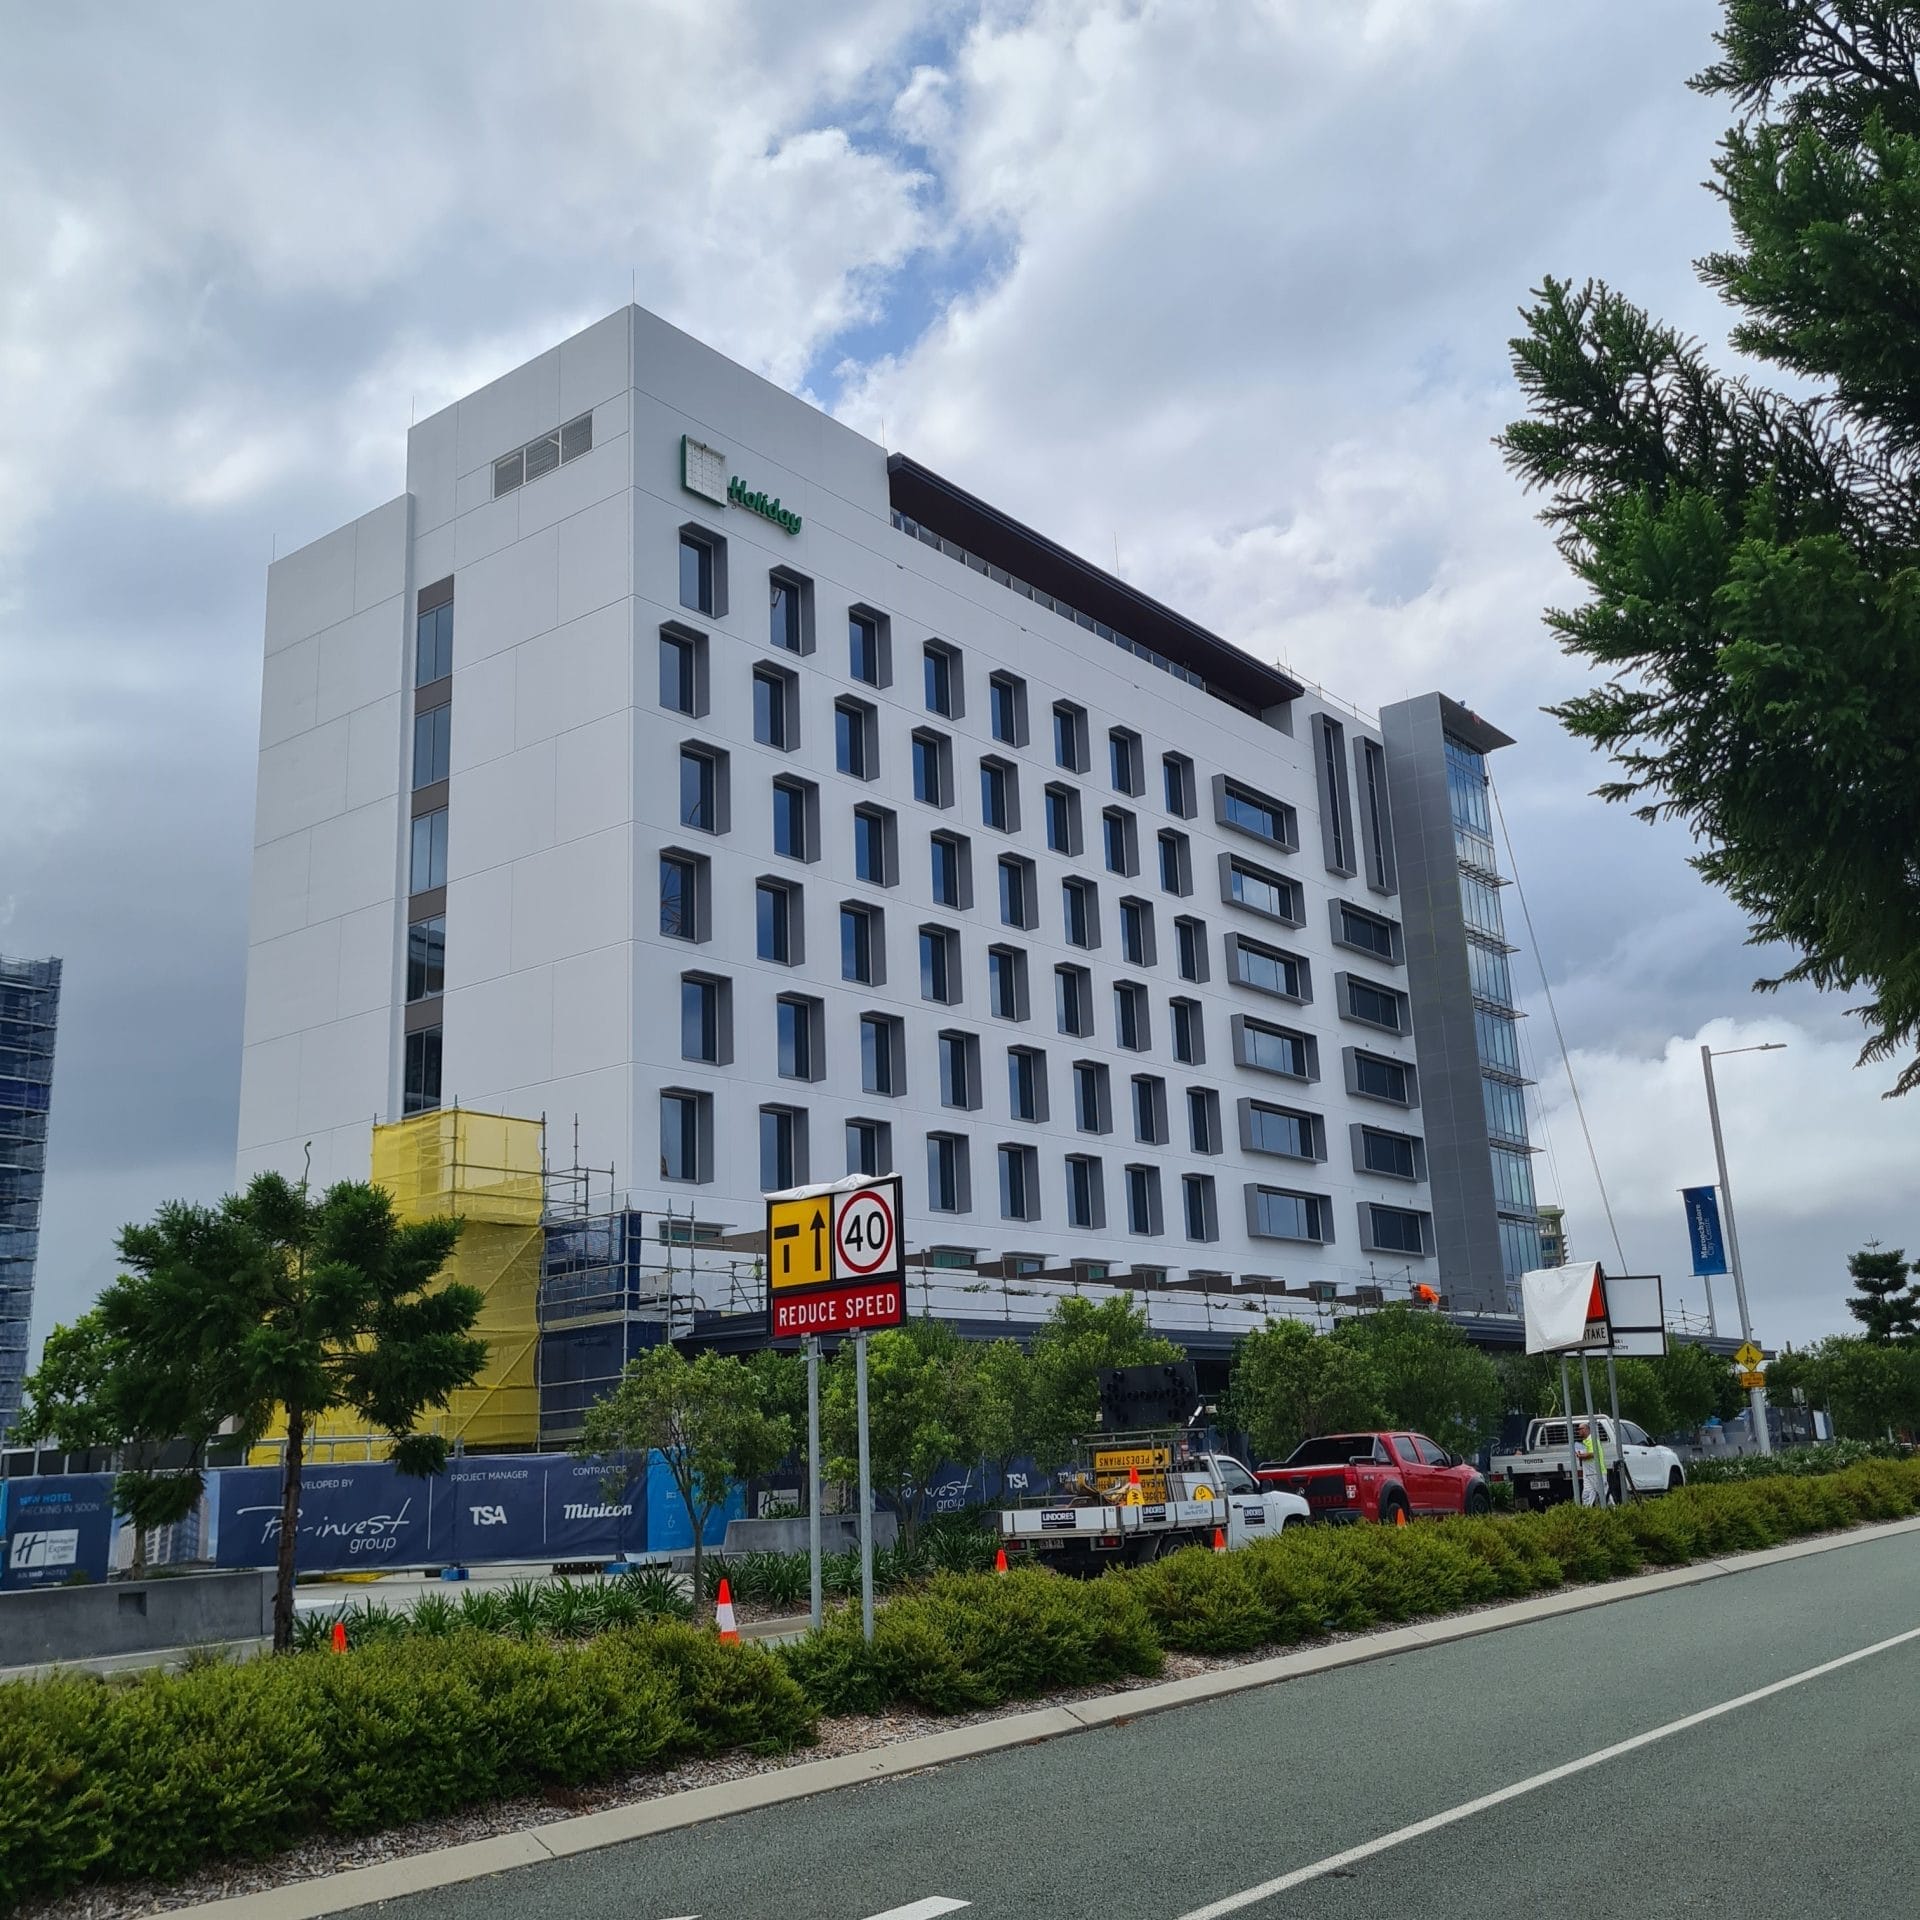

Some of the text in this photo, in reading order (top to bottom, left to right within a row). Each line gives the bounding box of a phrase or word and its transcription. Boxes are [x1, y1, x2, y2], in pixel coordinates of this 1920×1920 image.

[730, 475, 802, 534] Holiday
[845, 1211, 886, 1252] 40
[1695, 1204, 1708, 1259] Maroochydore
[778, 1293, 896, 1327] REDUCE SPEED
[1099, 1455, 1150, 1467] PEDESTRIANS
[450, 1470, 529, 1482] PROJECT MANAGER
[572, 1465, 627, 1477] CONTRACTOR
[301, 1478, 354, 1490] VELOPED BY
[1006, 1473, 1029, 1489] TSA
[43, 1493, 72, 1503] HOTEL
[937, 1498, 966, 1513] group
[469, 1505, 508, 1526] TSA
[563, 1502, 633, 1520] Minicon
[1042, 1512, 1074, 1521] LINDORES
[350, 1536, 397, 1554] group
